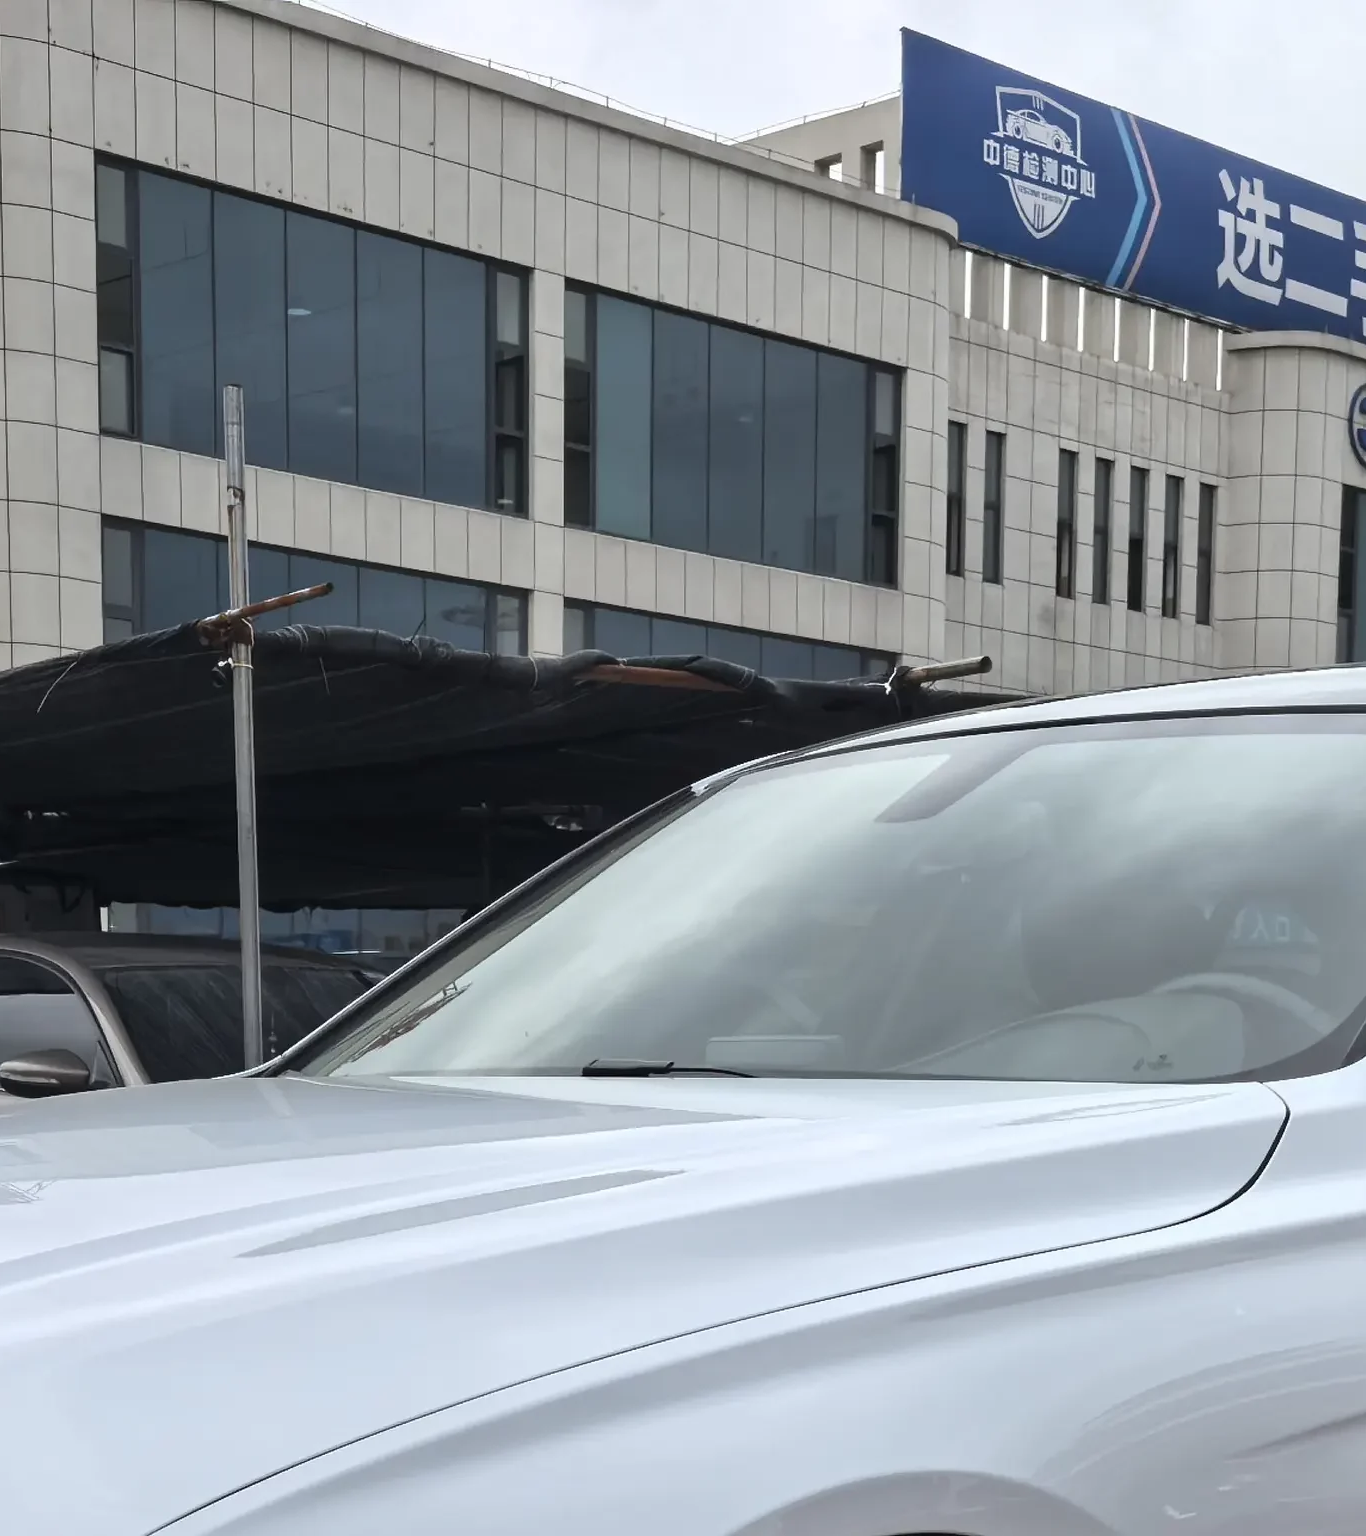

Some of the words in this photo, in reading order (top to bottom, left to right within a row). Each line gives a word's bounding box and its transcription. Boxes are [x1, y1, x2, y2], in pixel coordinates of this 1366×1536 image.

[983, 139, 1096, 198] 中德检测中心
